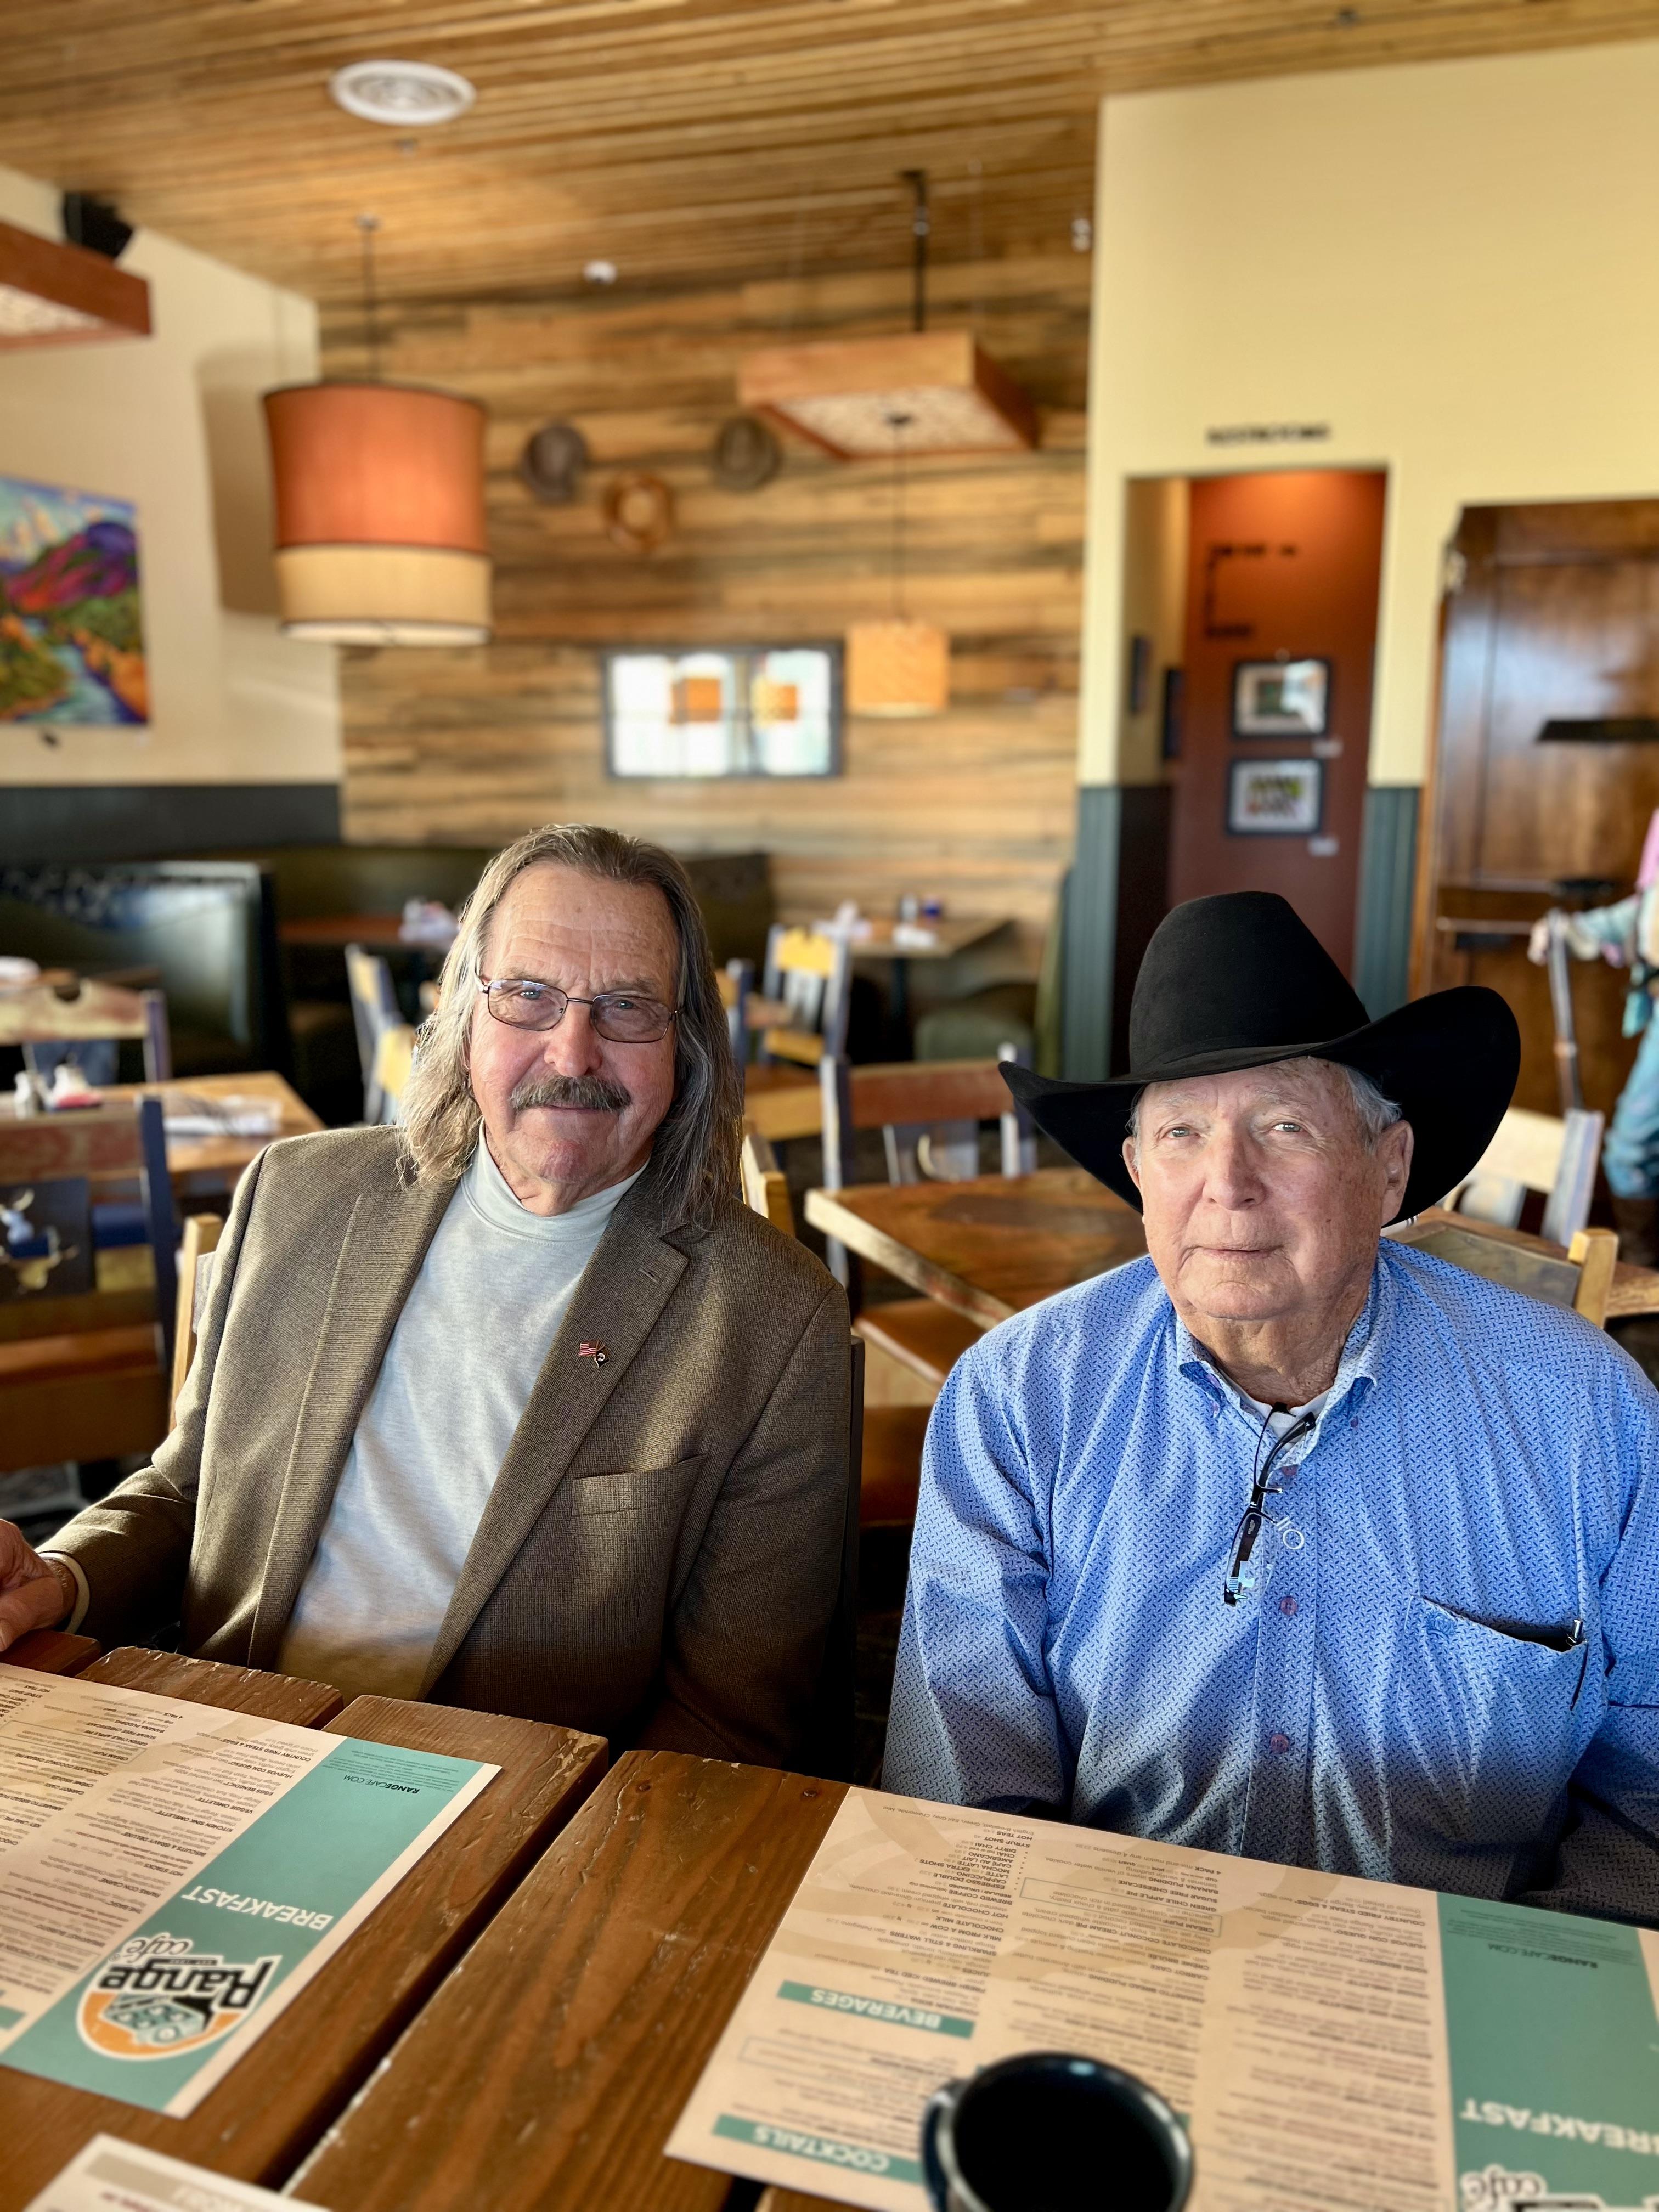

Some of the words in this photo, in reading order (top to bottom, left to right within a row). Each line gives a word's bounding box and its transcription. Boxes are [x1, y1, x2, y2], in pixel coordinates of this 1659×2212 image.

[280, 1753, 313, 1762] COUNTRY
[266, 1770, 294, 1779] HUEVOS
[342, 1775, 421, 1795] RANGECAFE.COM
[204, 1822, 235, 1832] KITCHEN
[1006, 1840, 1031, 1848] SYRUP
[919, 1859, 945, 1867] SHOTS
[968, 1852, 1014, 1864] AMERICANO
[946, 1864, 971, 1872] EXTRA
[957, 1860, 980, 1869] LATTE
[981, 1865, 1011, 1874] MOCHA
[992, 1861, 1012, 1870] CAFÉ
[933, 1872, 964, 1882] DOUBLE
[956, 1871, 1007, 1884] CAPPUCCINO
[966, 1878, 1005, 1890] ESPRESSO
[1118, 1880, 1168, 1893] CHEESECAKE
[1148, 1877, 1184, 1888] PUDDING
[948, 1889, 979, 1899] COFFEE
[1186, 1884, 1219, 1894] BANANA
[980, 1895, 1013, 1905] BREWED
[1140, 1893, 1164, 1902] APPLE
[1166, 1898, 1188, 1907] CHILE
[1190, 1894, 1218, 1903] SUGAR
[180, 1884, 335, 1931] BREAKFAST
[943, 1903, 990, 1916] CHOCOLATE
[1190, 1903, 1217, 1912] GREEN
[1330, 1905, 1355, 1914] STEAK
[1357, 1910, 1381, 1919] FRIED
[1384, 1915, 1425, 1927] COUNTRY
[956, 1920, 1005, 1933] CHOCOLATE
[1090, 1925, 1118, 1935] CREAM
[1186, 1923, 1214, 1933] CREAM
[889, 1931, 922, 1942] WATERS
[958, 1929, 981, 1938] FROM
[983, 1934, 1002, 1942] MILK
[1119, 1931, 1160, 1944] COCONUT
[923, 1938, 944, 1946] STILL
[126, 1936, 190, 1963] café
[1162, 1940, 1212, 1955] CHOCOLATE
[1150, 1964, 1172, 1973] CAKE
[1174, 1969, 1209, 1980] CARROT
[98, 1959, 274, 2009] Range
[809, 1988, 943, 2030] BEVERAGES
[751, 2123, 892, 2174] COCKTAILS
